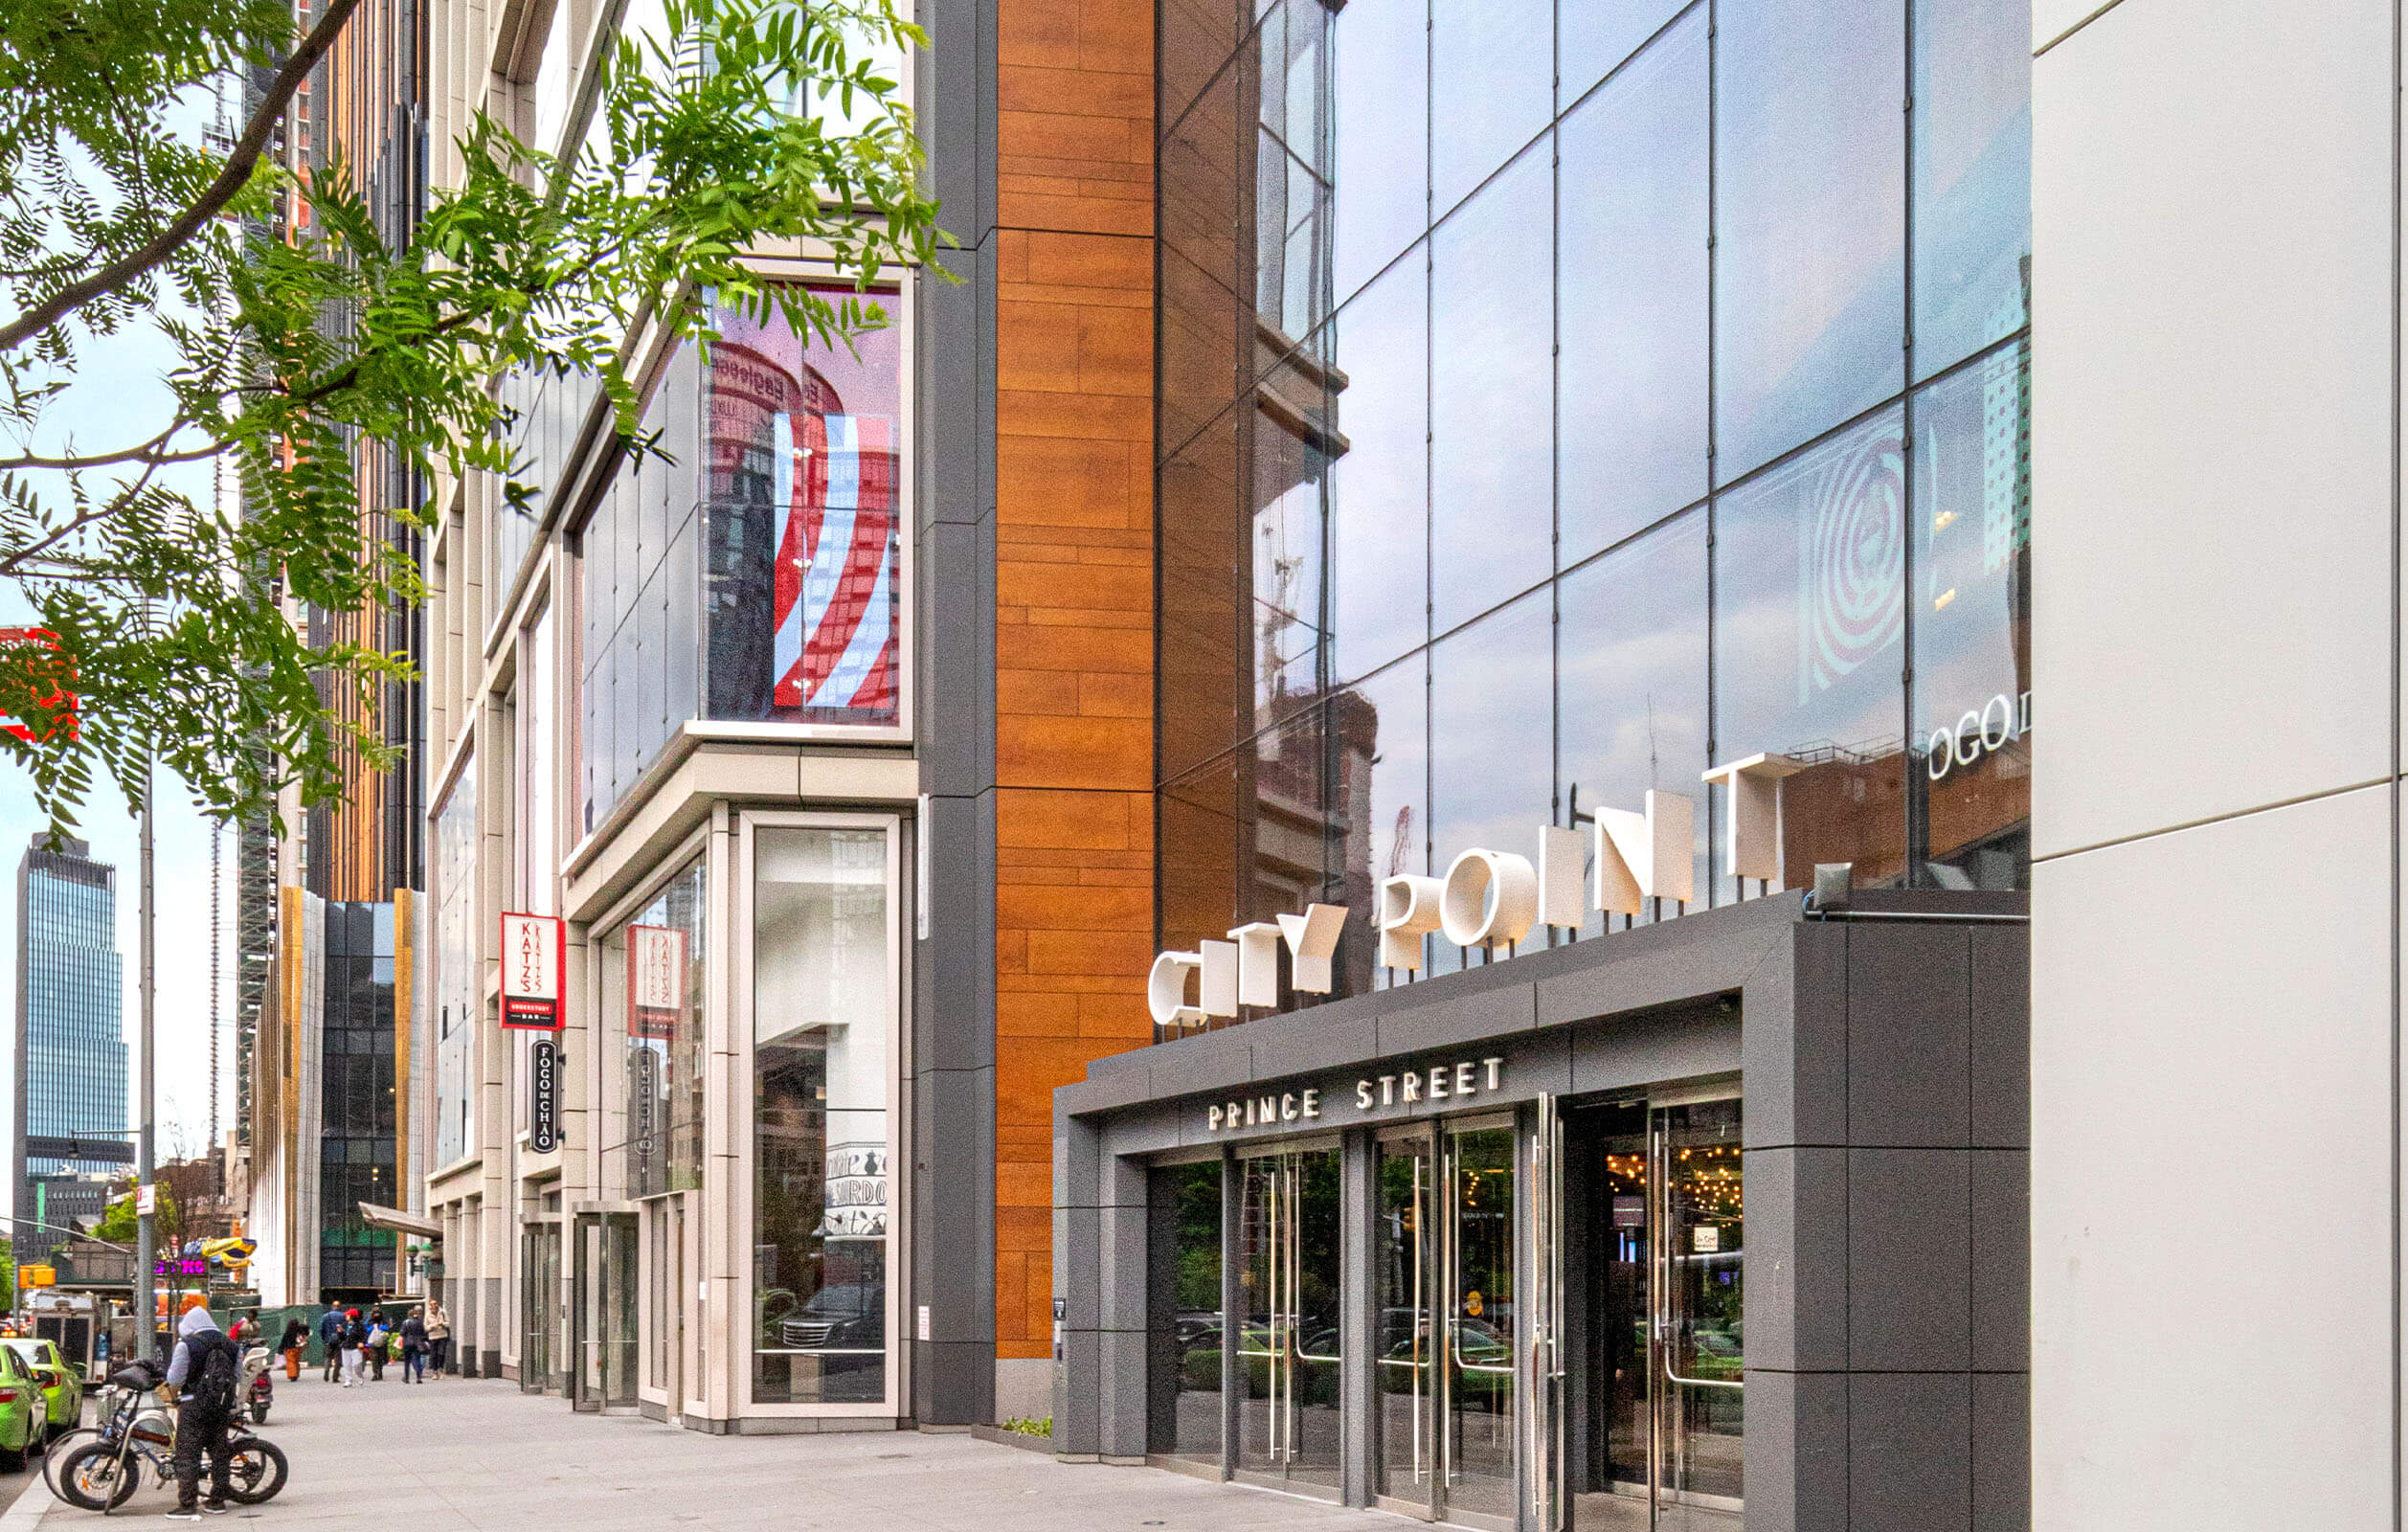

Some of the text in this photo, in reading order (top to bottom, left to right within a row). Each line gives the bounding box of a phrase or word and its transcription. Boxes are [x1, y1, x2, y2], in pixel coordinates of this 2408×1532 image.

[1147, 752, 1806, 1027] CITY POINT
[521, 922, 531, 993] KATZ'S
[539, 1047, 551, 1091] FOGO
[1208, 1057, 1504, 1131] PRINCE STREET
